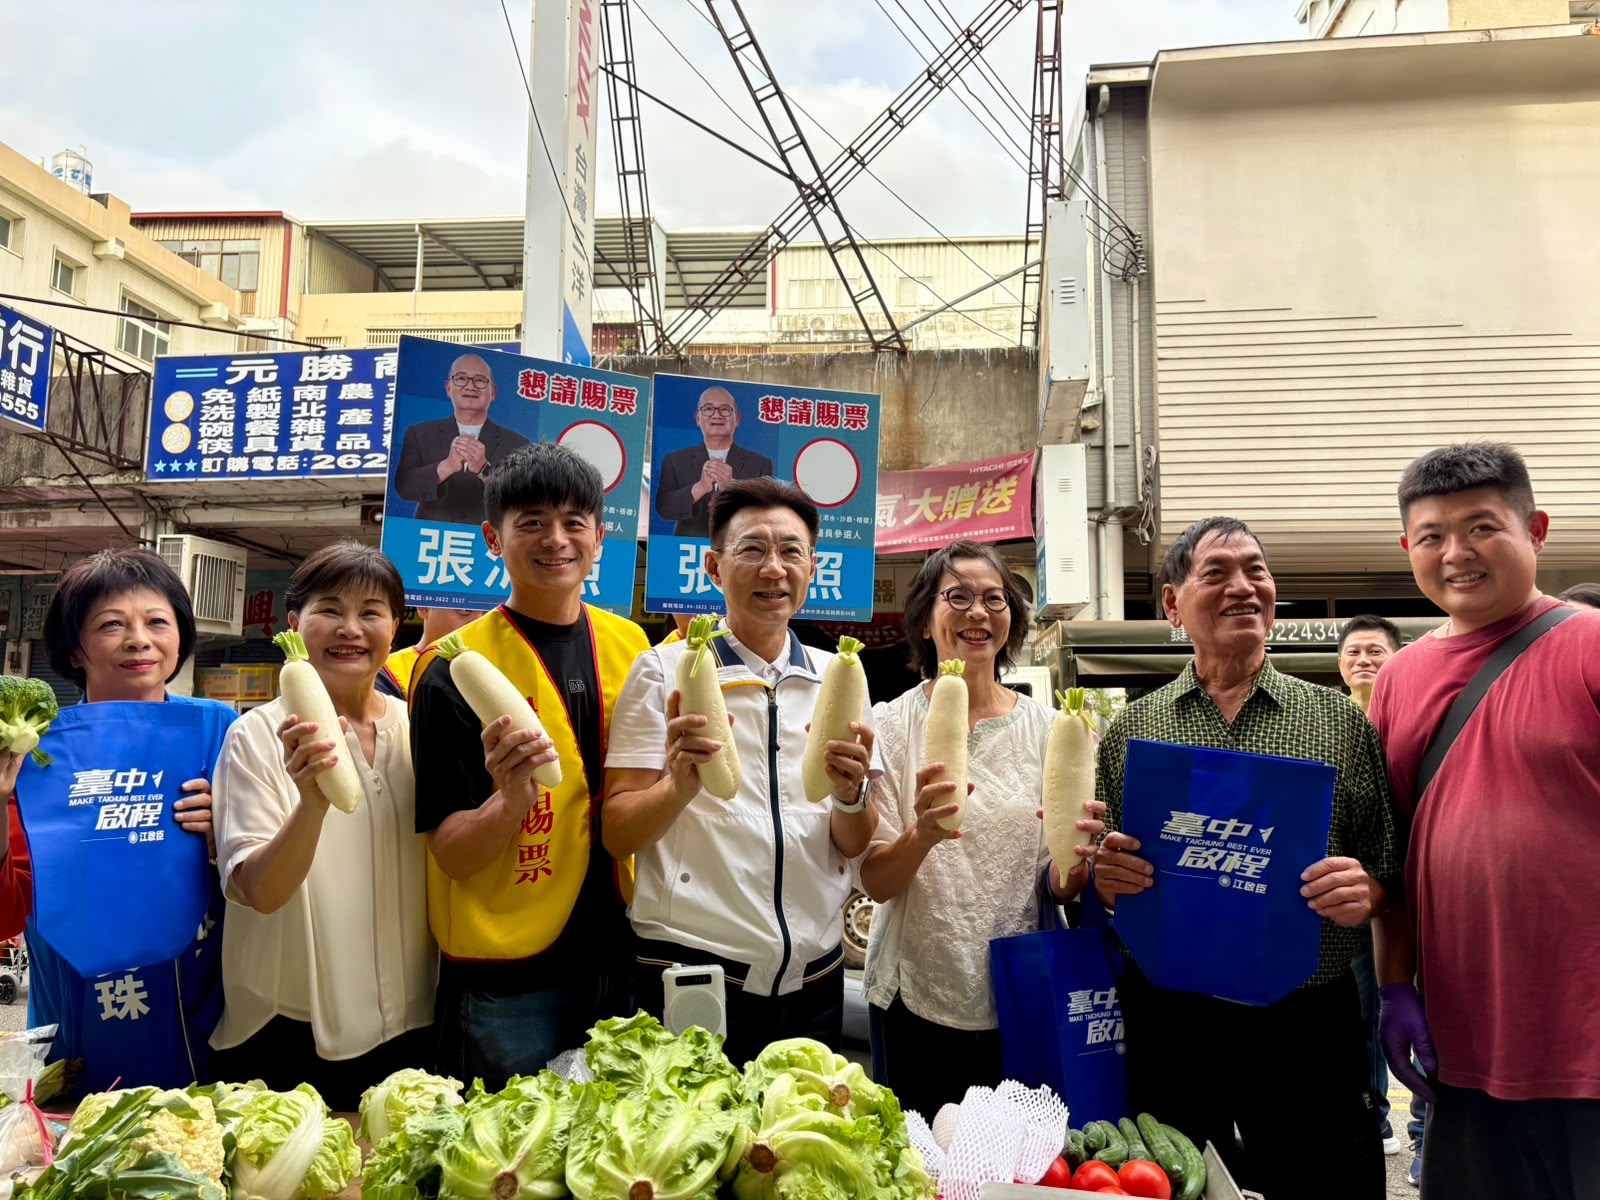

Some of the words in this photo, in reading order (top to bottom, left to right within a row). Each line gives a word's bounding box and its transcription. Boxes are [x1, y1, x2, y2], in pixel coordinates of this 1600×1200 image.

[517, 368, 638, 415] 懇請賜票
[197, 387, 236, 455] 免洗碗筷
[243, 386, 282, 453] 紙製餐具
[289, 384, 328, 452] 南北雜貨
[336, 382, 375, 451] 農產品
[758, 394, 869, 431] 懇請賜票
[69, 768, 148, 798] 臺中
[69, 797, 95, 807] MAKE
[97, 795, 129, 803] TAICHUNG
[130, 794, 146, 802] BEST
[147, 793, 164, 801] EVER
[1161, 810, 1253, 840] 臺中
[1160, 833, 1182, 843] MAKE
[1185, 837, 1225, 848] TAICHUNG
[1226, 841, 1249, 852] BEST
[1250, 846, 1272, 856] EVER
[94, 974, 151, 1021] 珠
[1067, 986, 1120, 1015] 臺中
[1069, 1014, 1084, 1023] MAKE
[1084, 1010, 1112, 1021] TAICHUNG
